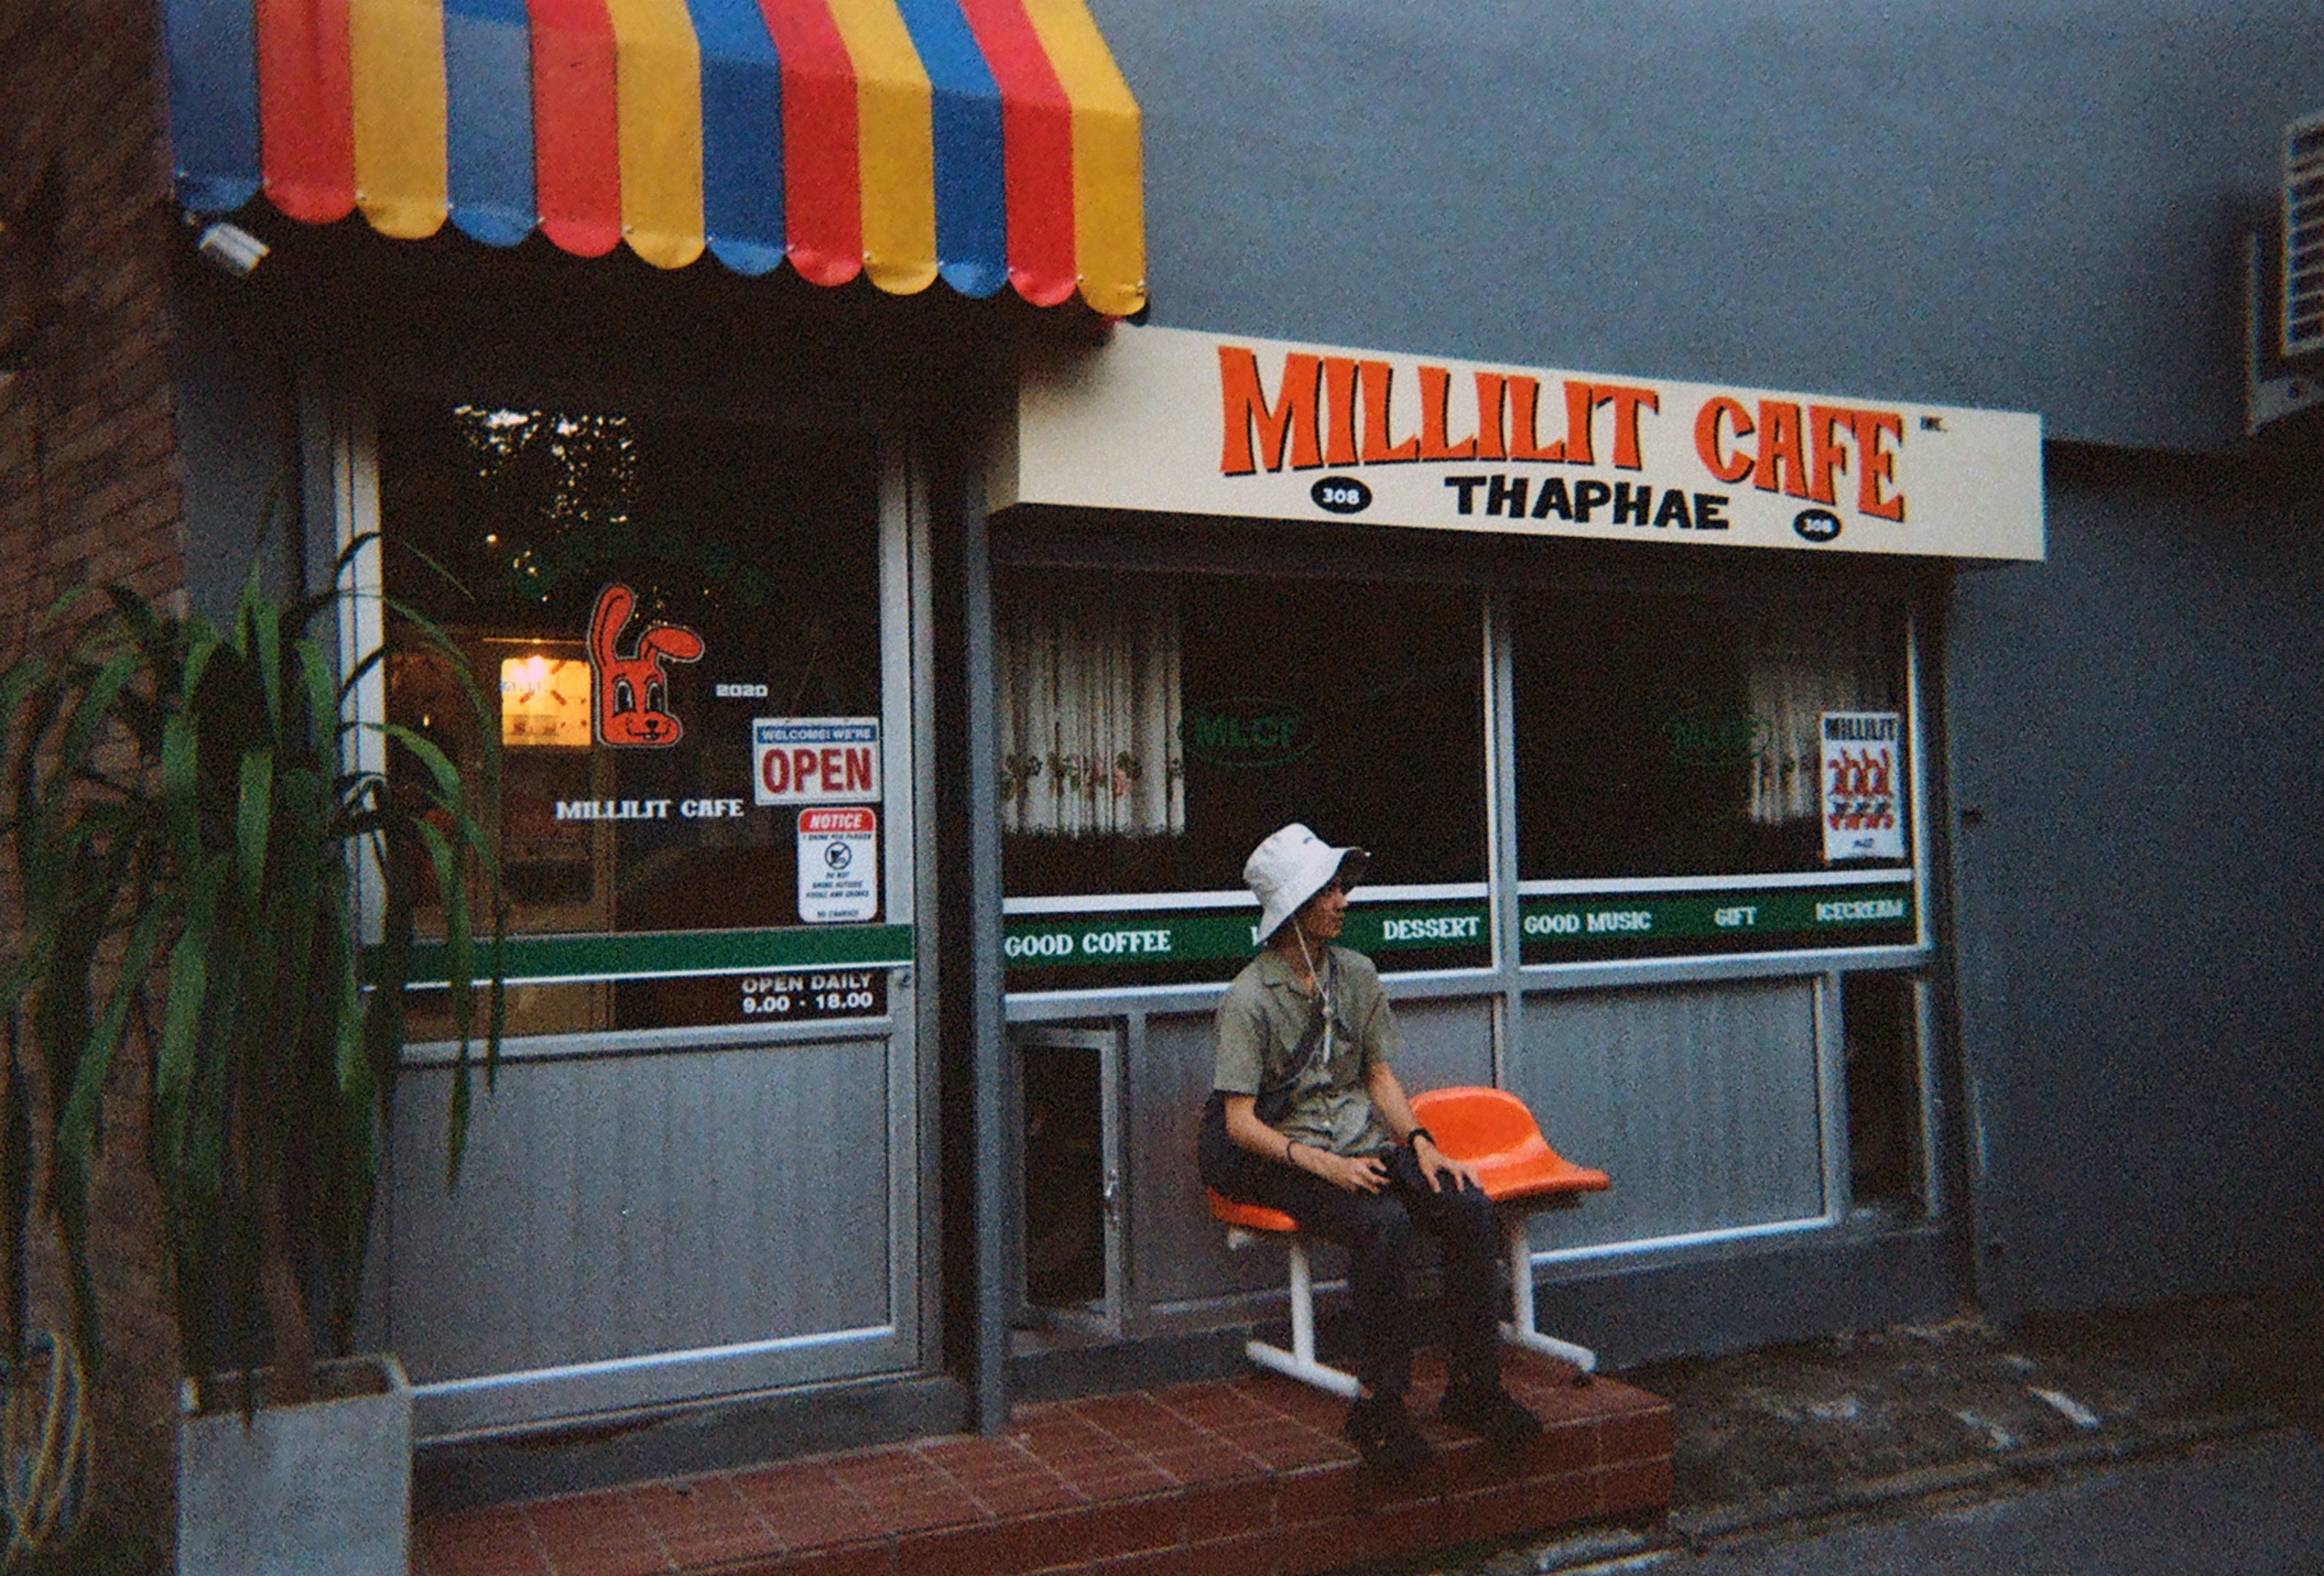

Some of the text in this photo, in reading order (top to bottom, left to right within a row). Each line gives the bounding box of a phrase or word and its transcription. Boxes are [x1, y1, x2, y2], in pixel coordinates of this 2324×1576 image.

[1218, 345, 1906, 523] MILLILIT CAFE
[1321, 487, 1360, 506] 308
[1444, 474, 1730, 530] THAPHAE
[715, 684, 768, 698] 2020
[762, 747, 873, 795] OPEN
[556, 798, 744, 819] MILLILIT CAFE
[809, 813, 862, 830] NOTICE
[1523, 911, 1652, 934] GOOD MUSIC
[1714, 906, 1758, 927] GIFT
[1383, 916, 1481, 940] DESSERT
[1004, 930, 1171, 957] GOOD COFFEE
[742, 972, 871, 994] OPEN DAILY
[742, 995, 790, 1013] 9.00
[816, 991, 873, 1010] 18.00
